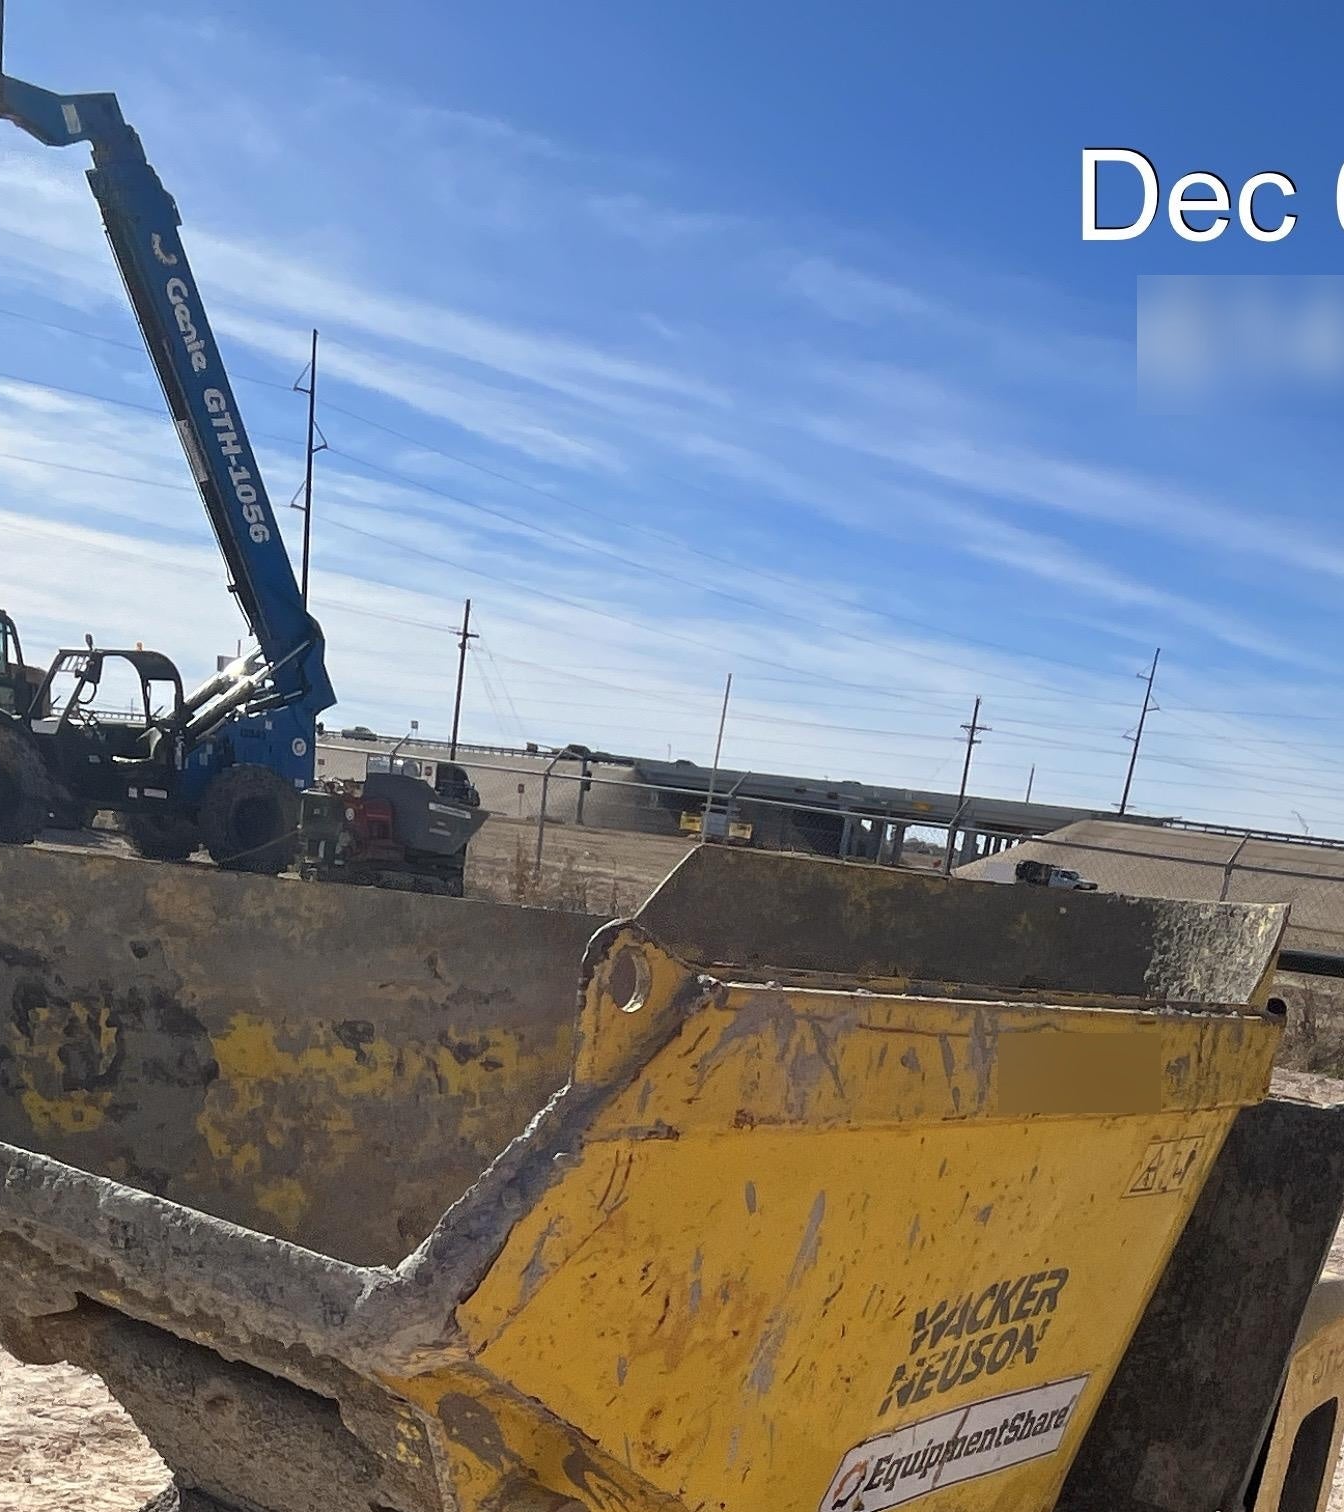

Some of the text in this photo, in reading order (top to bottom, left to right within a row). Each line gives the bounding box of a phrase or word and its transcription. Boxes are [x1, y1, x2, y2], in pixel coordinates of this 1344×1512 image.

[166, 277, 206, 372] Genie
[203, 387, 270, 544] GTH-1056
[909, 1267, 1070, 1356] WACKER
[877, 1318, 1052, 1418] NEUSON
[862, 1403, 1071, 1493] EquipmentShare
